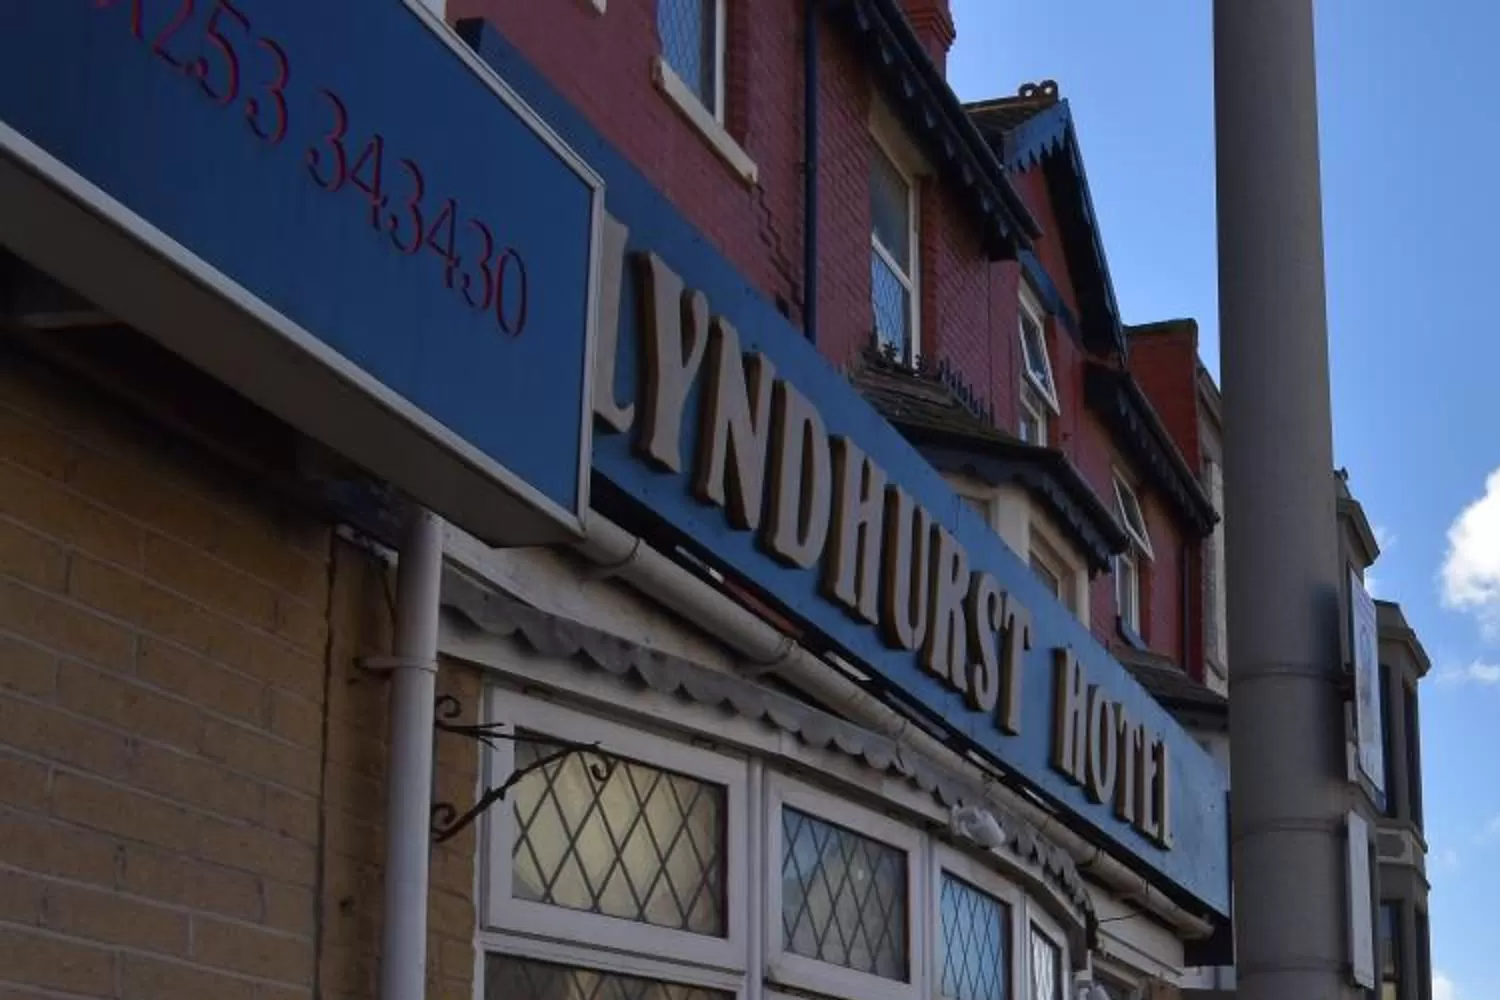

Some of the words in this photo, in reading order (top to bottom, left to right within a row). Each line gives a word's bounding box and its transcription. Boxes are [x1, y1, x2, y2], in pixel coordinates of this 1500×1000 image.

[306, 87, 527, 338] 343430
[592, 212, 1032, 736] LYNDHURST
[1051, 648, 1175, 851] HOTEL
